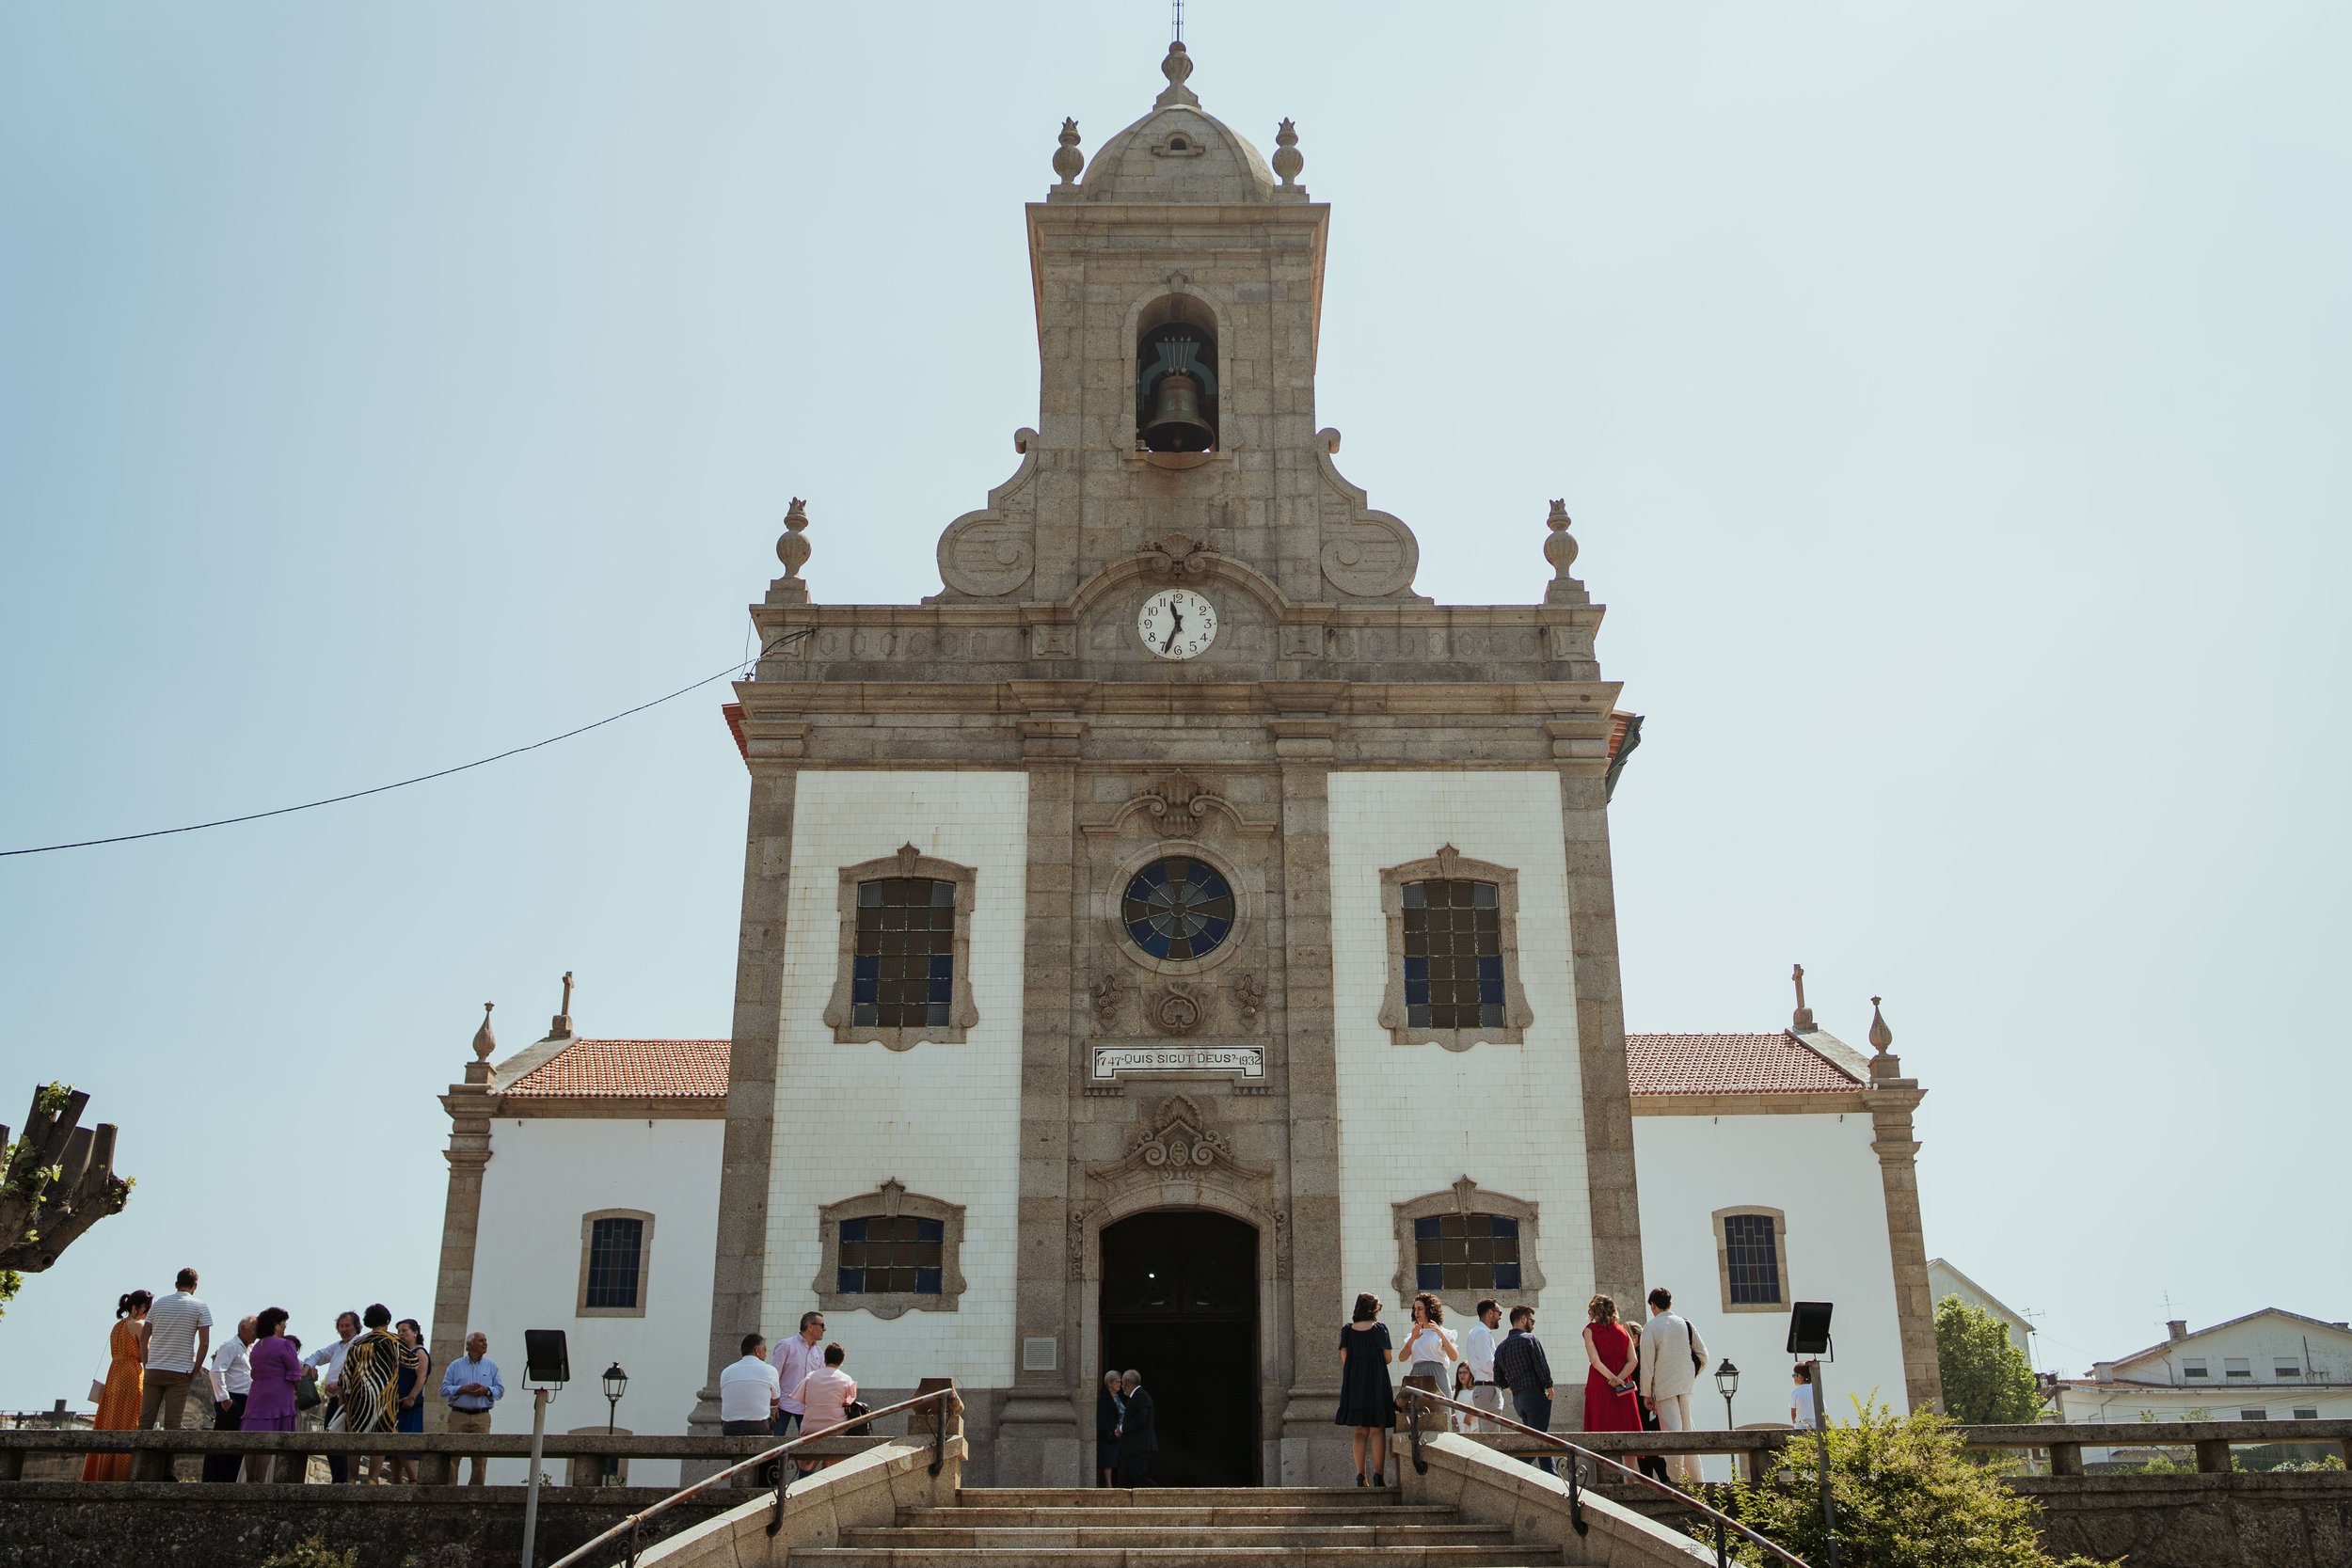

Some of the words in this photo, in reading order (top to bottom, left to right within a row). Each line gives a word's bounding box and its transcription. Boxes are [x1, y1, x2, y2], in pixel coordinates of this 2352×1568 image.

[1159, 597, 1166, 607] 11
[1173, 594, 1183, 603] 12
[1190, 597, 1194, 607] 1
[1148, 607, 1158, 616] 10
[1199, 606, 1206, 615] 2
[1144, 619, 1152, 629] 9
[1203, 618, 1212, 628] 3
[1148, 632, 1155, 642] 8
[1200, 632, 1208, 641] 4
[1159, 641, 1166, 651] 7
[1173, 645, 1183, 656] 6
[1189, 641, 1197, 652] 5
[1157, 1054, 1193, 1063] SICUT
